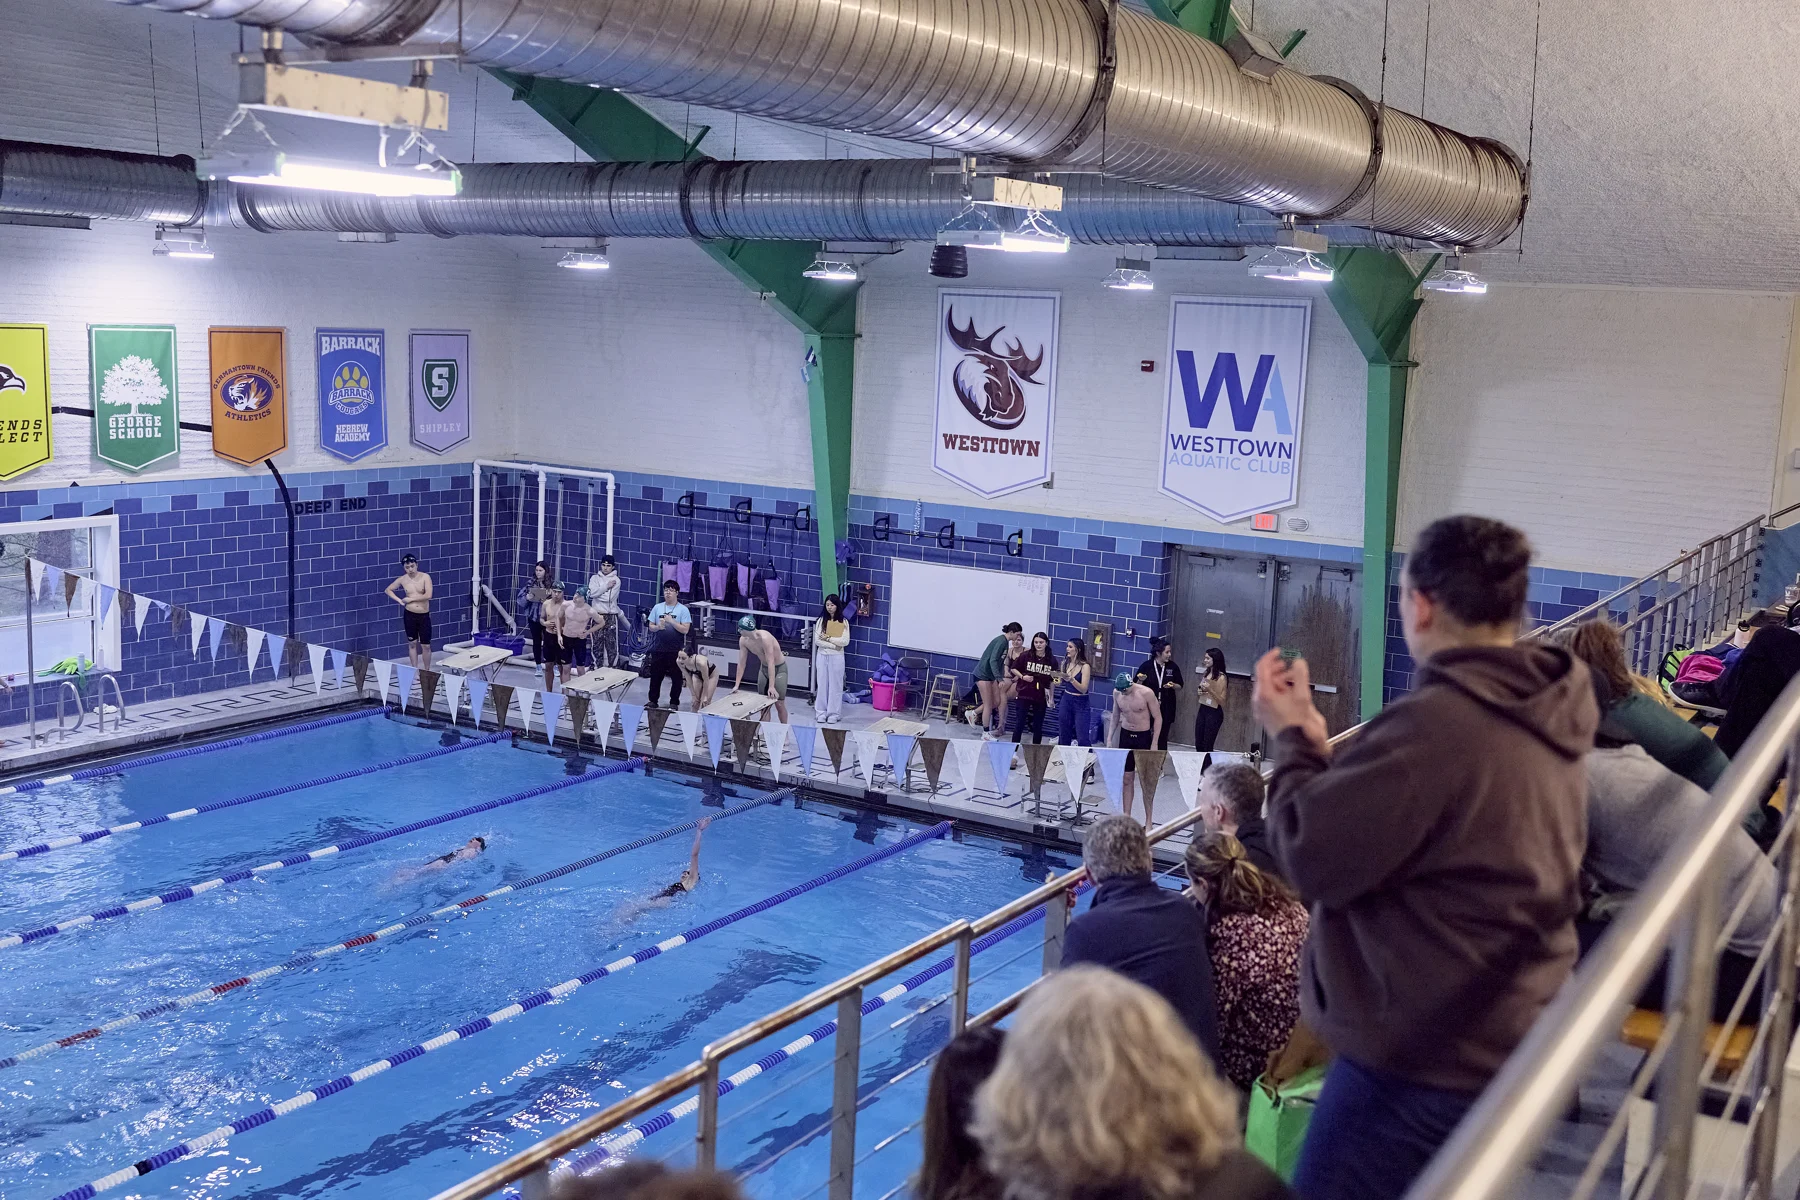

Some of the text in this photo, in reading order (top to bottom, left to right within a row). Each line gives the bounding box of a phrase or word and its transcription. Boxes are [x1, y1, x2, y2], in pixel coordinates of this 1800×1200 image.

[321, 336, 380, 356] BARRACK
[213, 365, 280, 389] GERMANTOWN FRIENDS
[432, 367, 449, 397] S
[332, 387, 373, 402] BARRACK
[335, 400, 368, 415] COUGARS
[109, 415, 162, 428] GEORGE
[225, 409, 271, 422] ATHLETICS
[109, 427, 162, 440] SCHOOL
[336, 423, 369, 434] HEBREW
[419, 423, 462, 434] SHIPLEY
[334, 432, 370, 443] ACADEMY
[942, 433, 1041, 457] WESTTOWN
[1170, 433, 1293, 460] WESTTOWN
[1168, 452, 1291, 475] AQUATIC CLUB
[294, 497, 367, 515] DEEP END
[1255, 514, 1276, 529] EXIT
[1026, 661, 1052, 675] EAGLES
